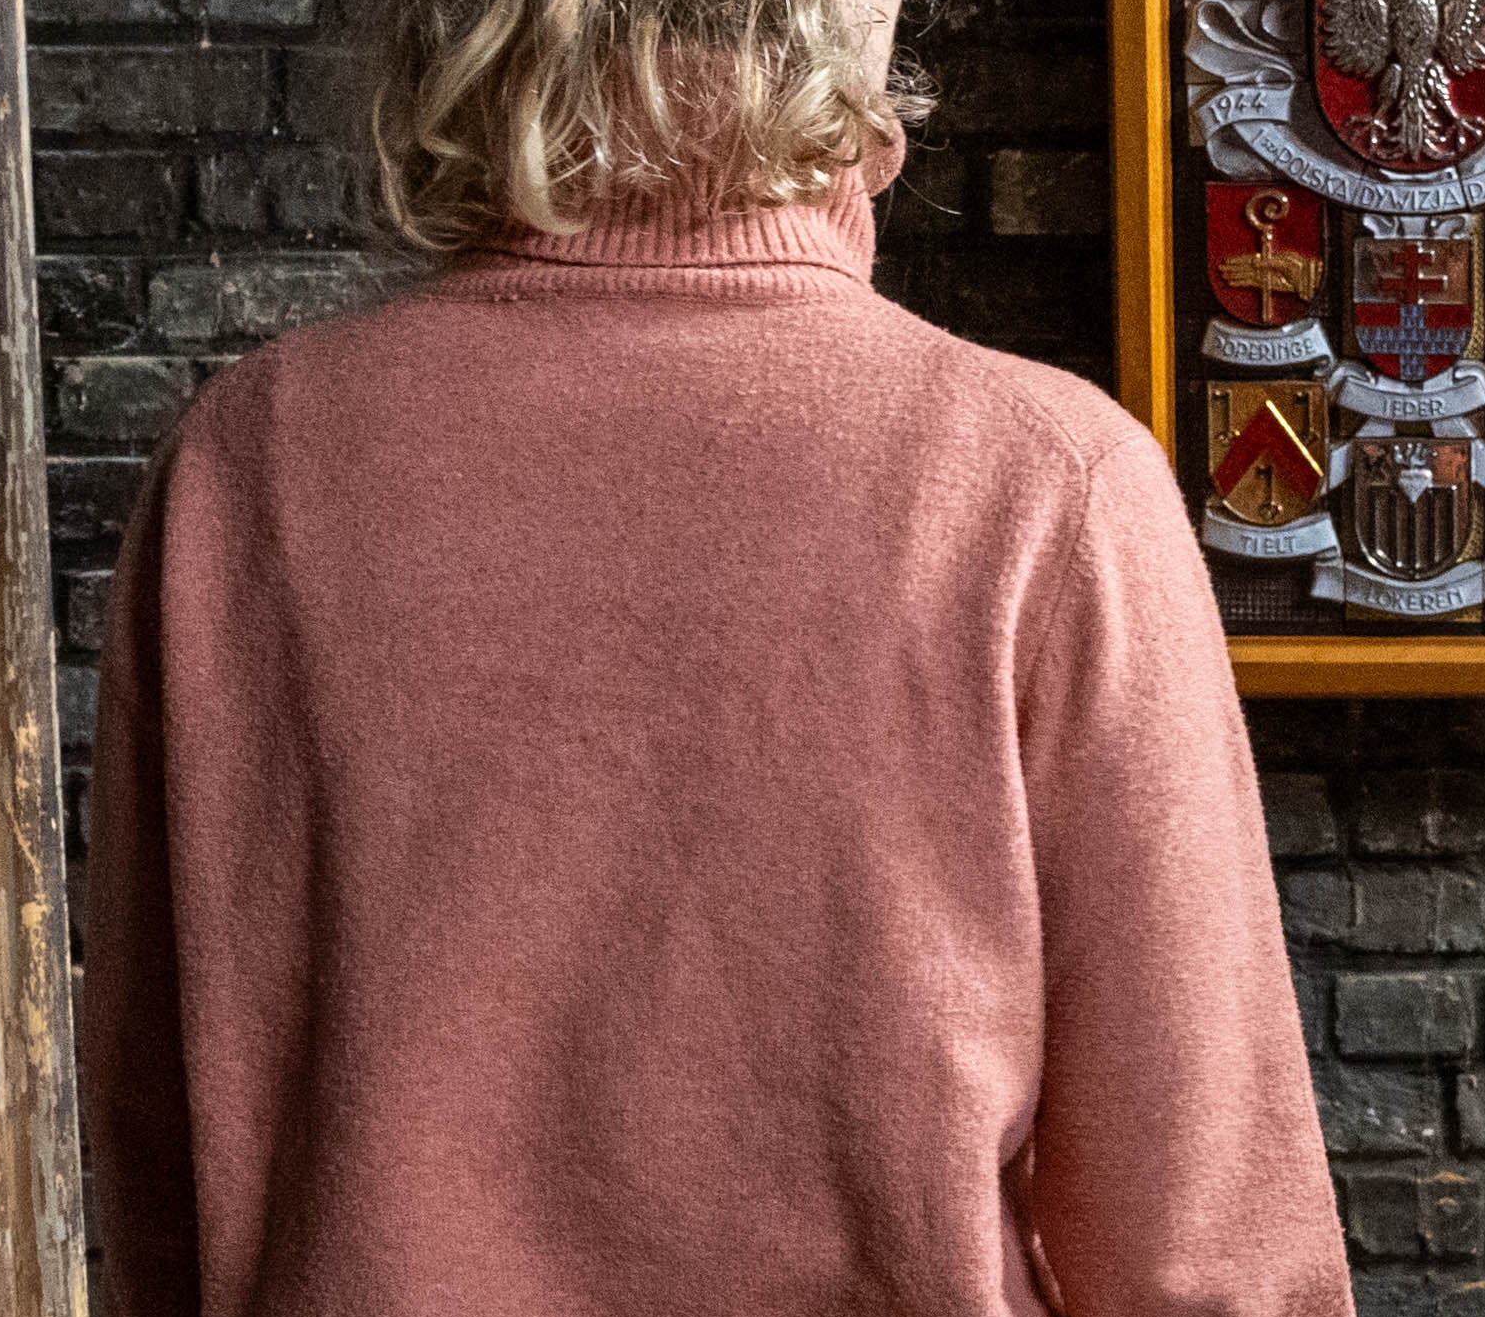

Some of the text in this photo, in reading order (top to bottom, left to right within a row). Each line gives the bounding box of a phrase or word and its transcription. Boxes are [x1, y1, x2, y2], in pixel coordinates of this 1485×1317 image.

[1208, 92, 1266, 123] 1944
[1273, 146, 1348, 201] POLSKA
[1361, 185, 1461, 211] DYWIZJA
[1383, 399, 1445, 418] IEPER
[1240, 534, 1296, 556] TIELT
[1365, 590, 1464, 611] LOKEREN
